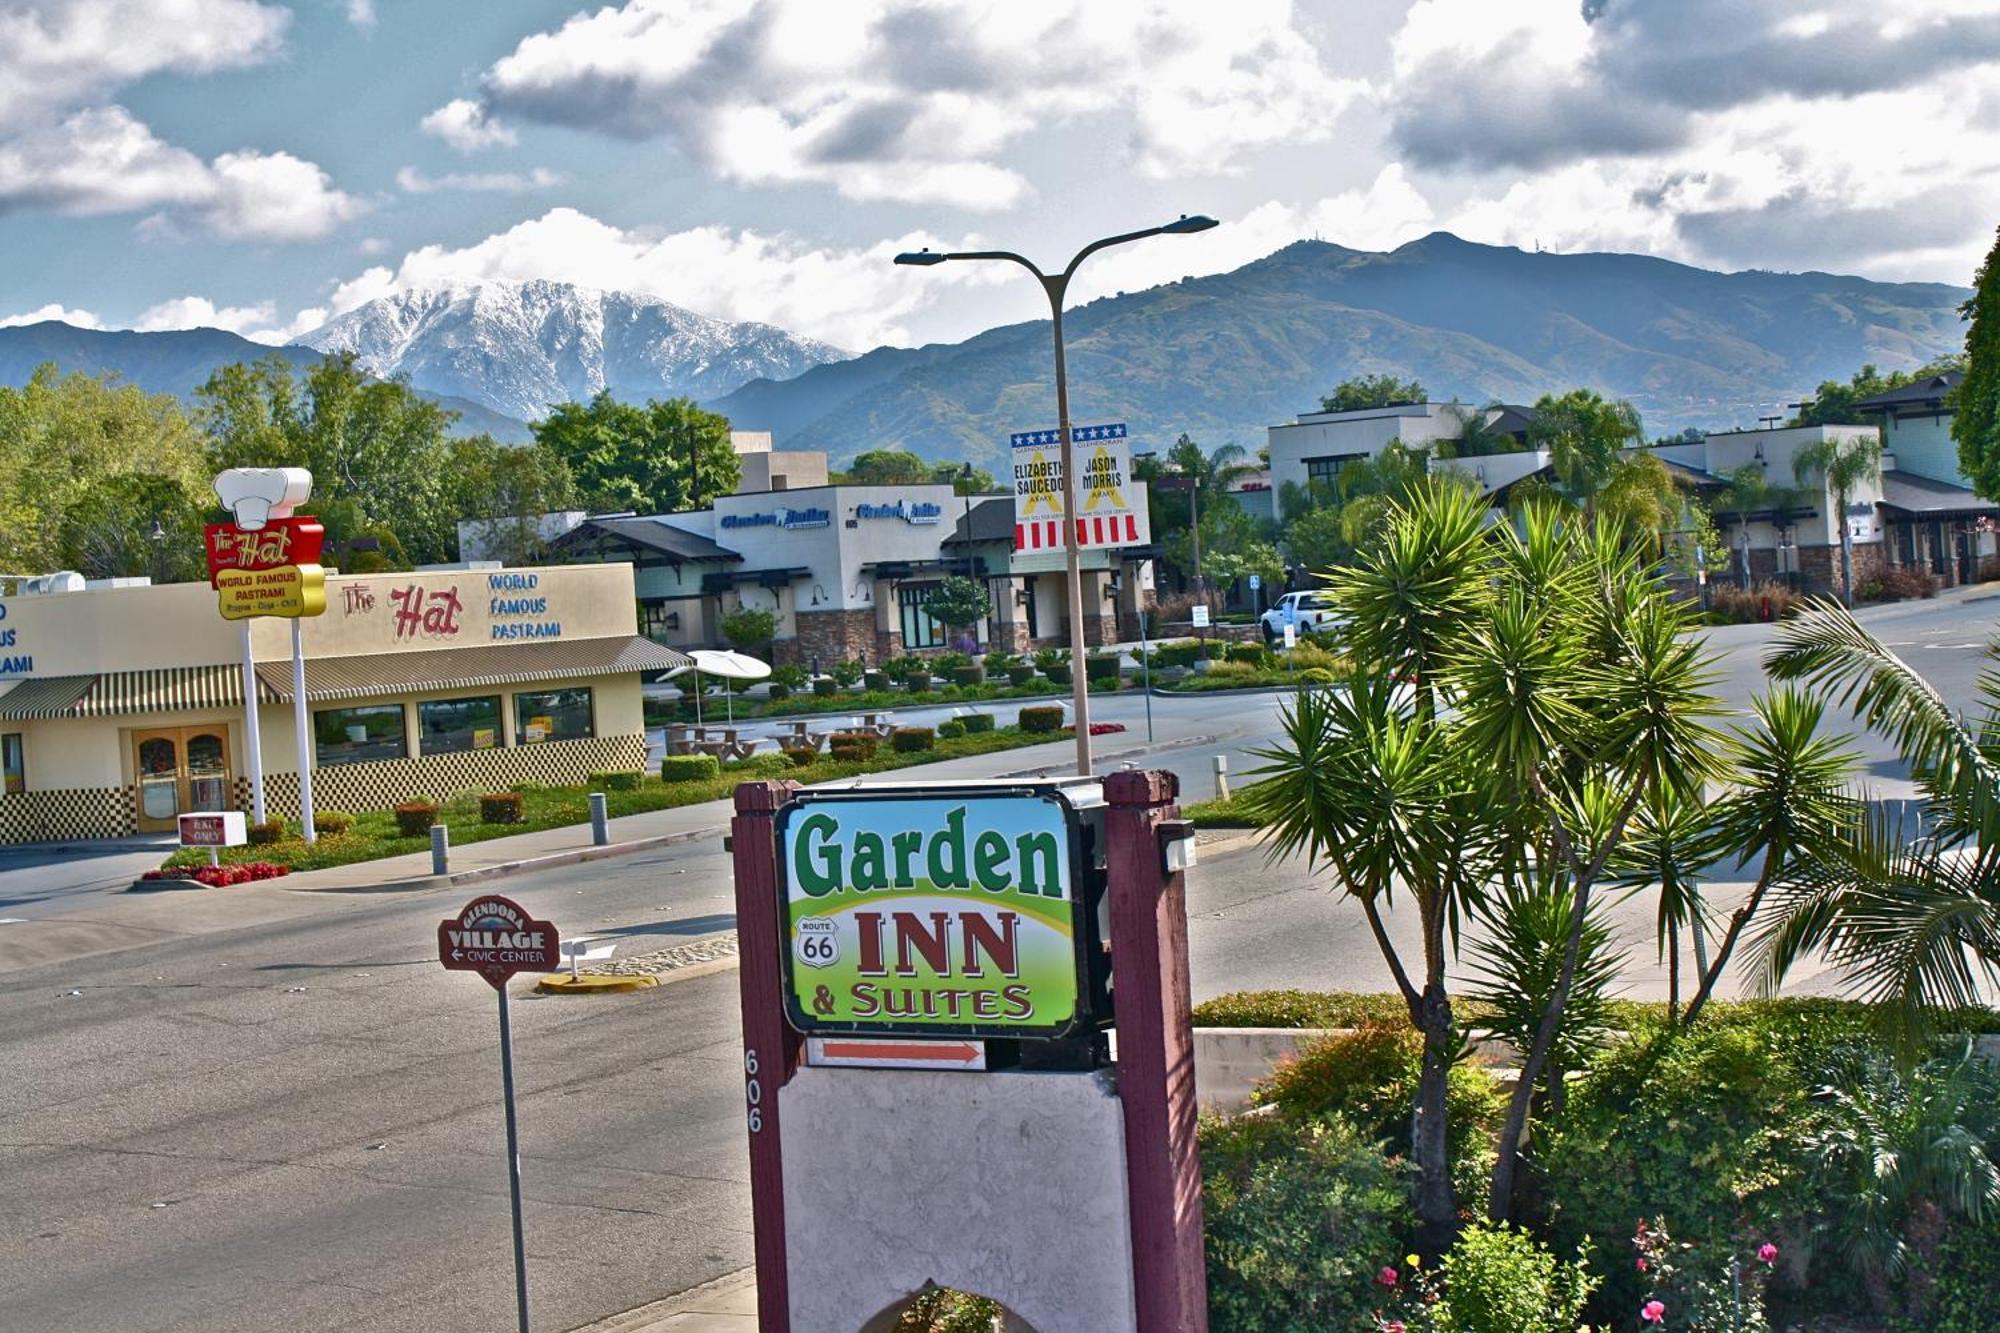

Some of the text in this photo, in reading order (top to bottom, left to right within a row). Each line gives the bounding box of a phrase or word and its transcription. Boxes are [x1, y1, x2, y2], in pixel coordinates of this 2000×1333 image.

[1085, 456, 1117, 473] JASON
[1017, 477, 1064, 495] SAUCEDO
[1082, 472, 1122, 490] MORRIS
[1092, 489, 1116, 498] ARMY
[233, 526, 292, 567] Hat
[218, 572, 296, 588] WORLD FAMOUS
[488, 574, 538, 590] WORLD
[236, 588, 285, 600] PASTRAMI
[342, 582, 463, 637] The Hat
[490, 597, 546, 614] FAMOUS
[492, 622, 561, 639] PASTRAMI
[193, 831, 221, 841] ONLY
[795, 806, 1063, 898] Garden
[463, 902, 524, 930] GLENDORA
[448, 930, 545, 949] VILLAGE
[803, 936, 833, 959] 66
[854, 912, 1019, 977] INN
[467, 951, 545, 962] CIVIC CENTER
[812, 983, 1034, 1020] & SUITES
